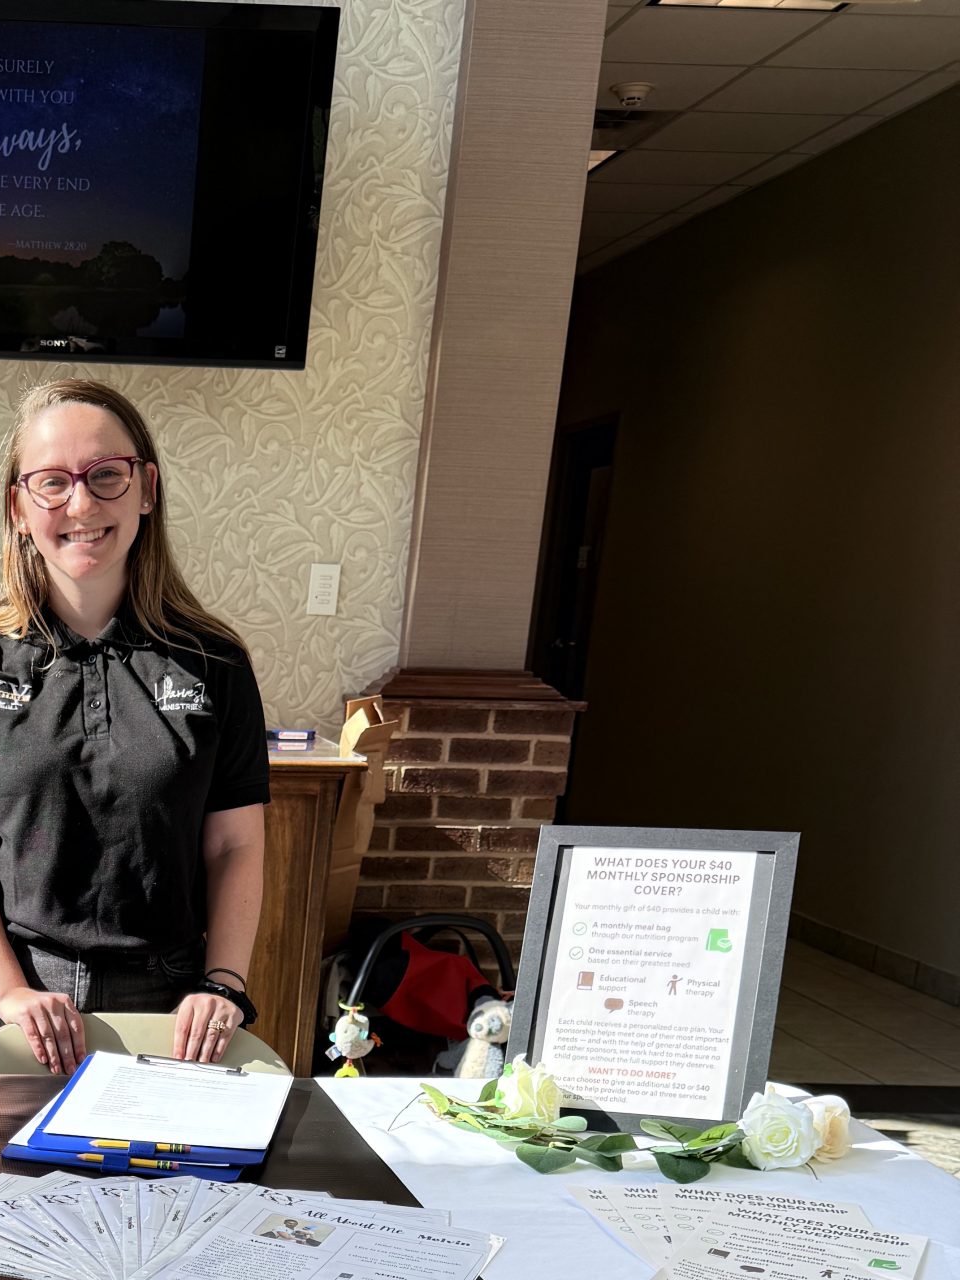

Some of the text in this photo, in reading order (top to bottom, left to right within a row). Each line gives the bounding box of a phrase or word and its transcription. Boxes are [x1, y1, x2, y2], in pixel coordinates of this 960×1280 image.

[40, 90, 75, 104] YOU
[12, 176, 52, 190] VERY
[58, 178, 90, 191] END
[11, 205, 45, 218] AGE.
[151, 674, 205, 706] Harvest
[160, 703, 202, 711] MINISTRIES
[594, 857, 732, 871] WHAT DOES YOUR $40
[587, 871, 741, 885] MONTHLY SPONSORSHIP
[634, 885, 683, 896] COVER?
[592, 904, 621, 912] monthly
[663, 906, 694, 915] provides
[601, 923, 633, 931] monthly
[656, 925, 671, 933] bag
[592, 932, 620, 940] through
[636, 933, 666, 941] nutrition
[667, 935, 699, 943] program
[589, 947, 604, 955] One
[644, 950, 672, 958] service
[588, 957, 610, 965] based
[622, 958, 639, 966] their
[640, 960, 670, 968] greatest
[600, 975, 720, 988] Educational Physical
[685, 989, 714, 998] therapy
[628, 1000, 658, 1008] Speech
[628, 1009, 656, 1018] therapy
[588, 1067, 614, 1076] WANT
[630, 1069, 644, 1077] DO
[645, 1070, 677, 1080] MORE?
[679, 1189, 723, 1197] WHAT
[725, 1192, 763, 1201] DOES
[767, 1196, 806, 1205] YOUR
[748, 1202, 848, 1215] SPONSORSHIP
[302, 1210, 327, 1220] All
[331, 1216, 376, 1230] About
[737, 1208, 900, 1240] WHAT DOES YOUR $40
[728, 1212, 910, 1247] MONTHLY SPONSORSHIP
[782, 1228, 841, 1240] COVER?
